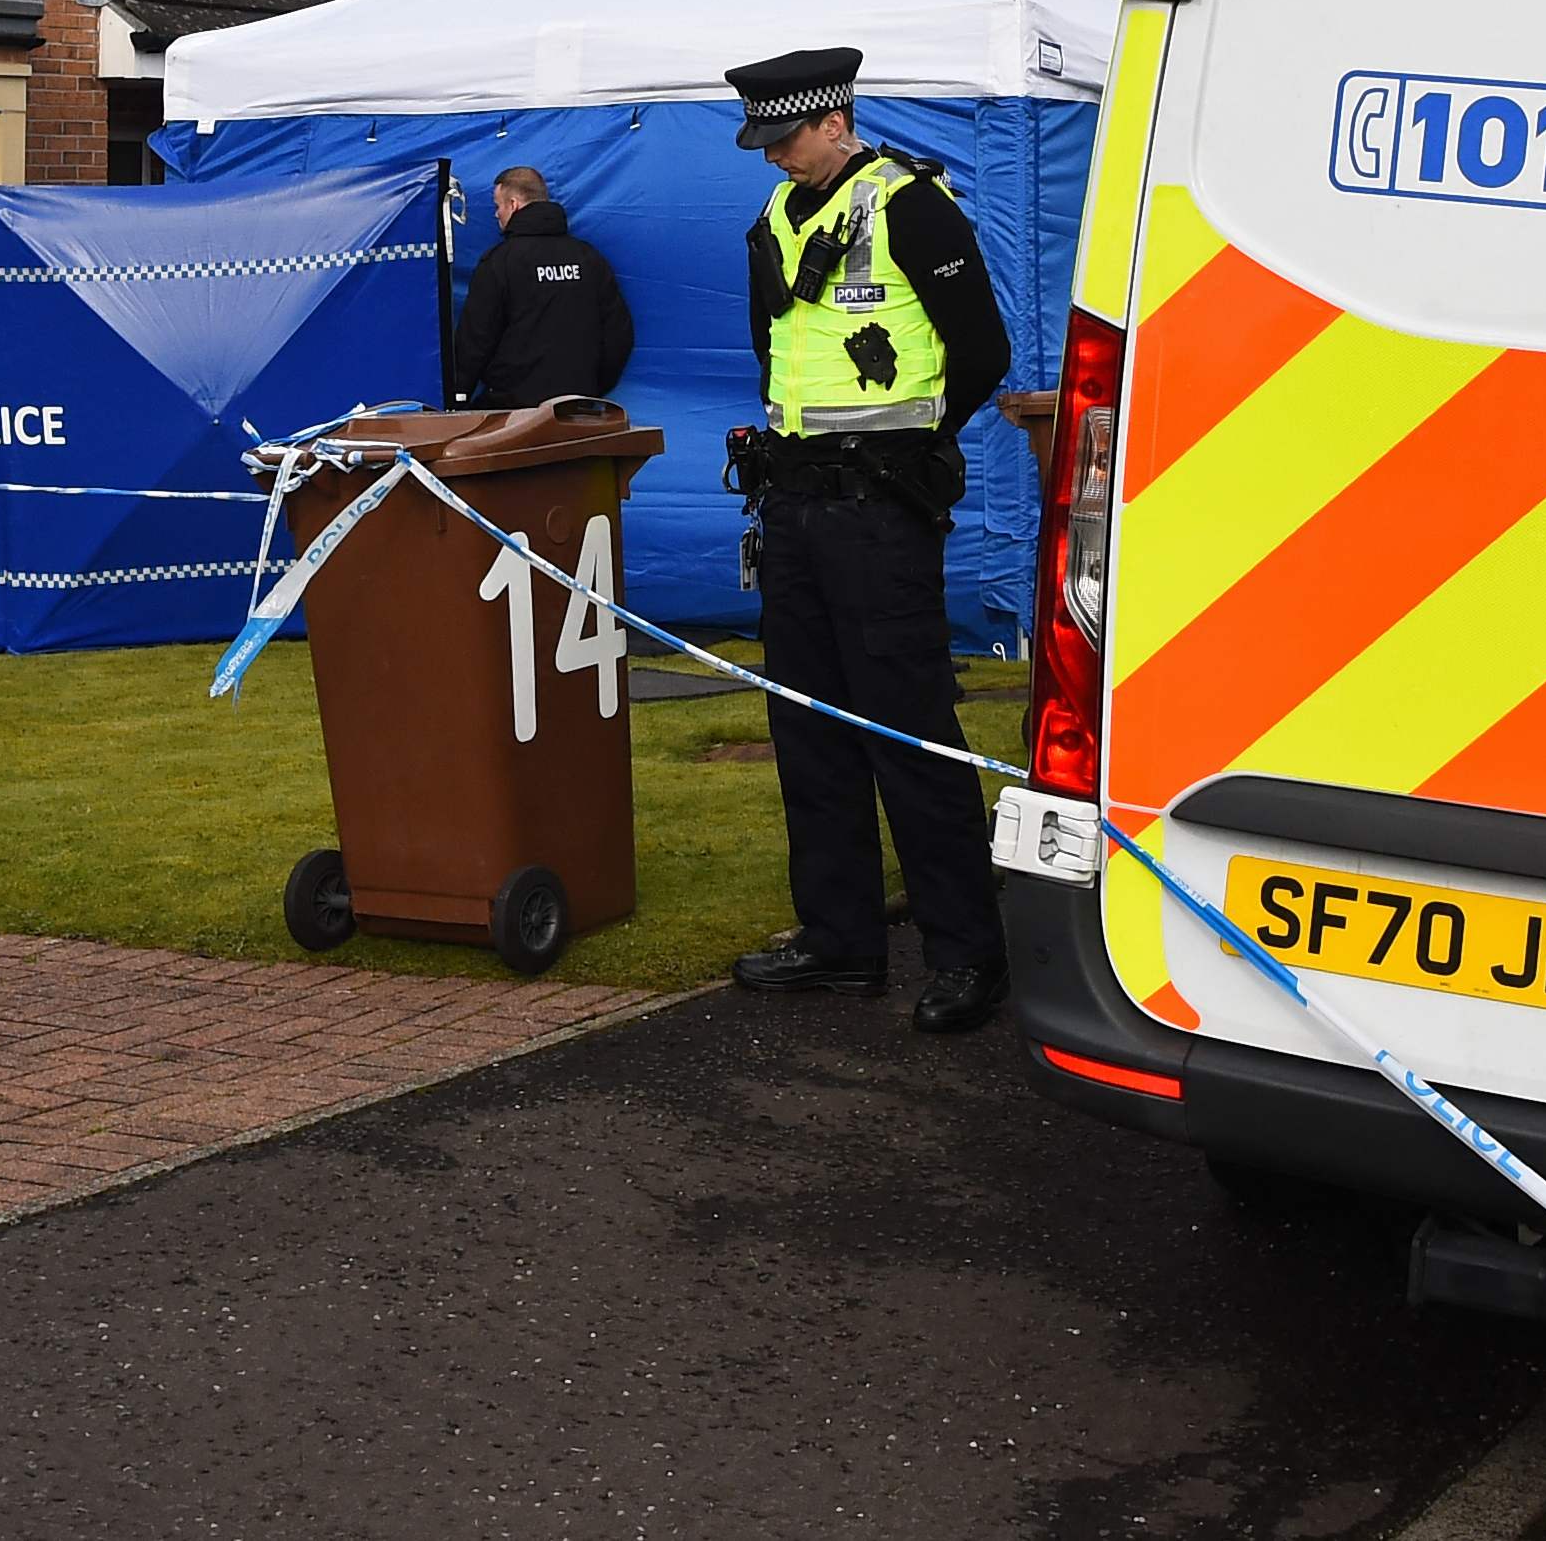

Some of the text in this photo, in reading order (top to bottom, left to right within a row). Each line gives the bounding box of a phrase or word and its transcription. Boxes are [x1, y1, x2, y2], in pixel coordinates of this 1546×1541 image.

[536, 264, 581, 282] POLICE
[836, 287, 883, 302] POLICE
[479, 514, 627, 743] 14
[1256, 875, 1465, 977] SF70
